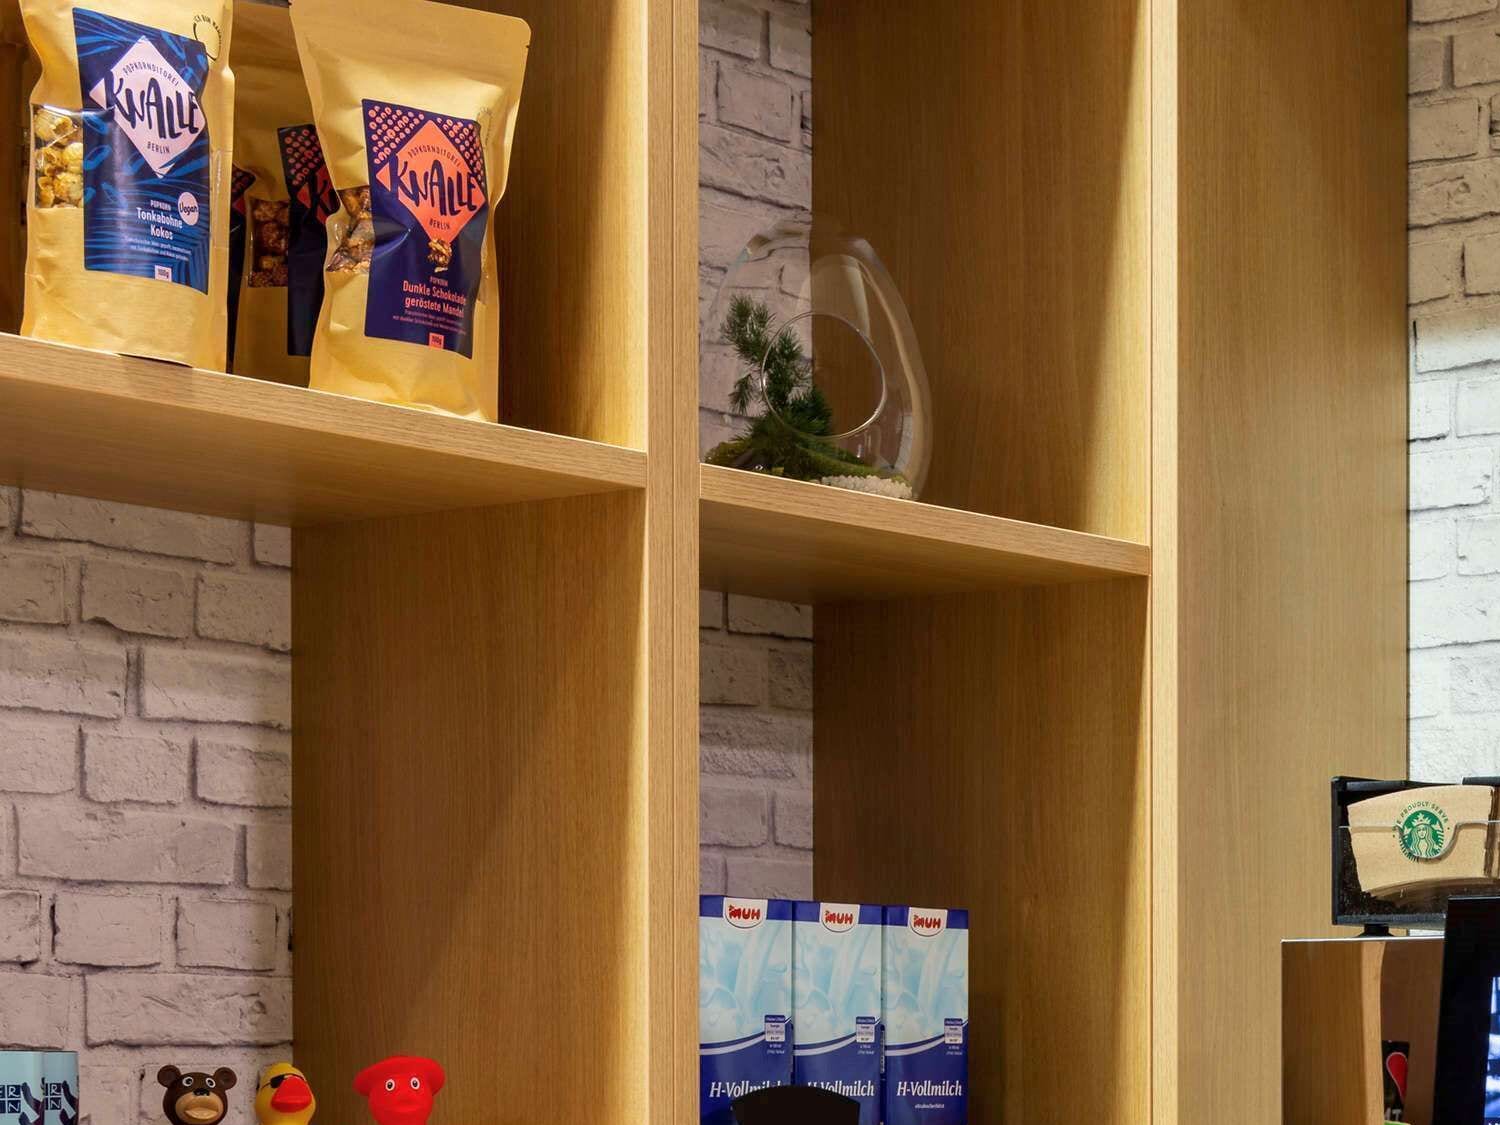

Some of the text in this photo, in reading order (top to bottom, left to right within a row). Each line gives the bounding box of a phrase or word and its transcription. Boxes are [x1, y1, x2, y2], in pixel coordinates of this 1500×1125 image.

[147, 141, 170, 154] BERLIN
[136, 207, 183, 229] Tonkabohne
[150, 224, 174, 240] Kokos
[403, 280, 431, 296] Dunkle
[404, 297, 441, 312] geröstete
[728, 905, 761, 920] MUH
[825, 910, 854, 925] MUH
[913, 915, 941, 929] MUH
[896, 1080, 963, 1097] H-Vollmilch
